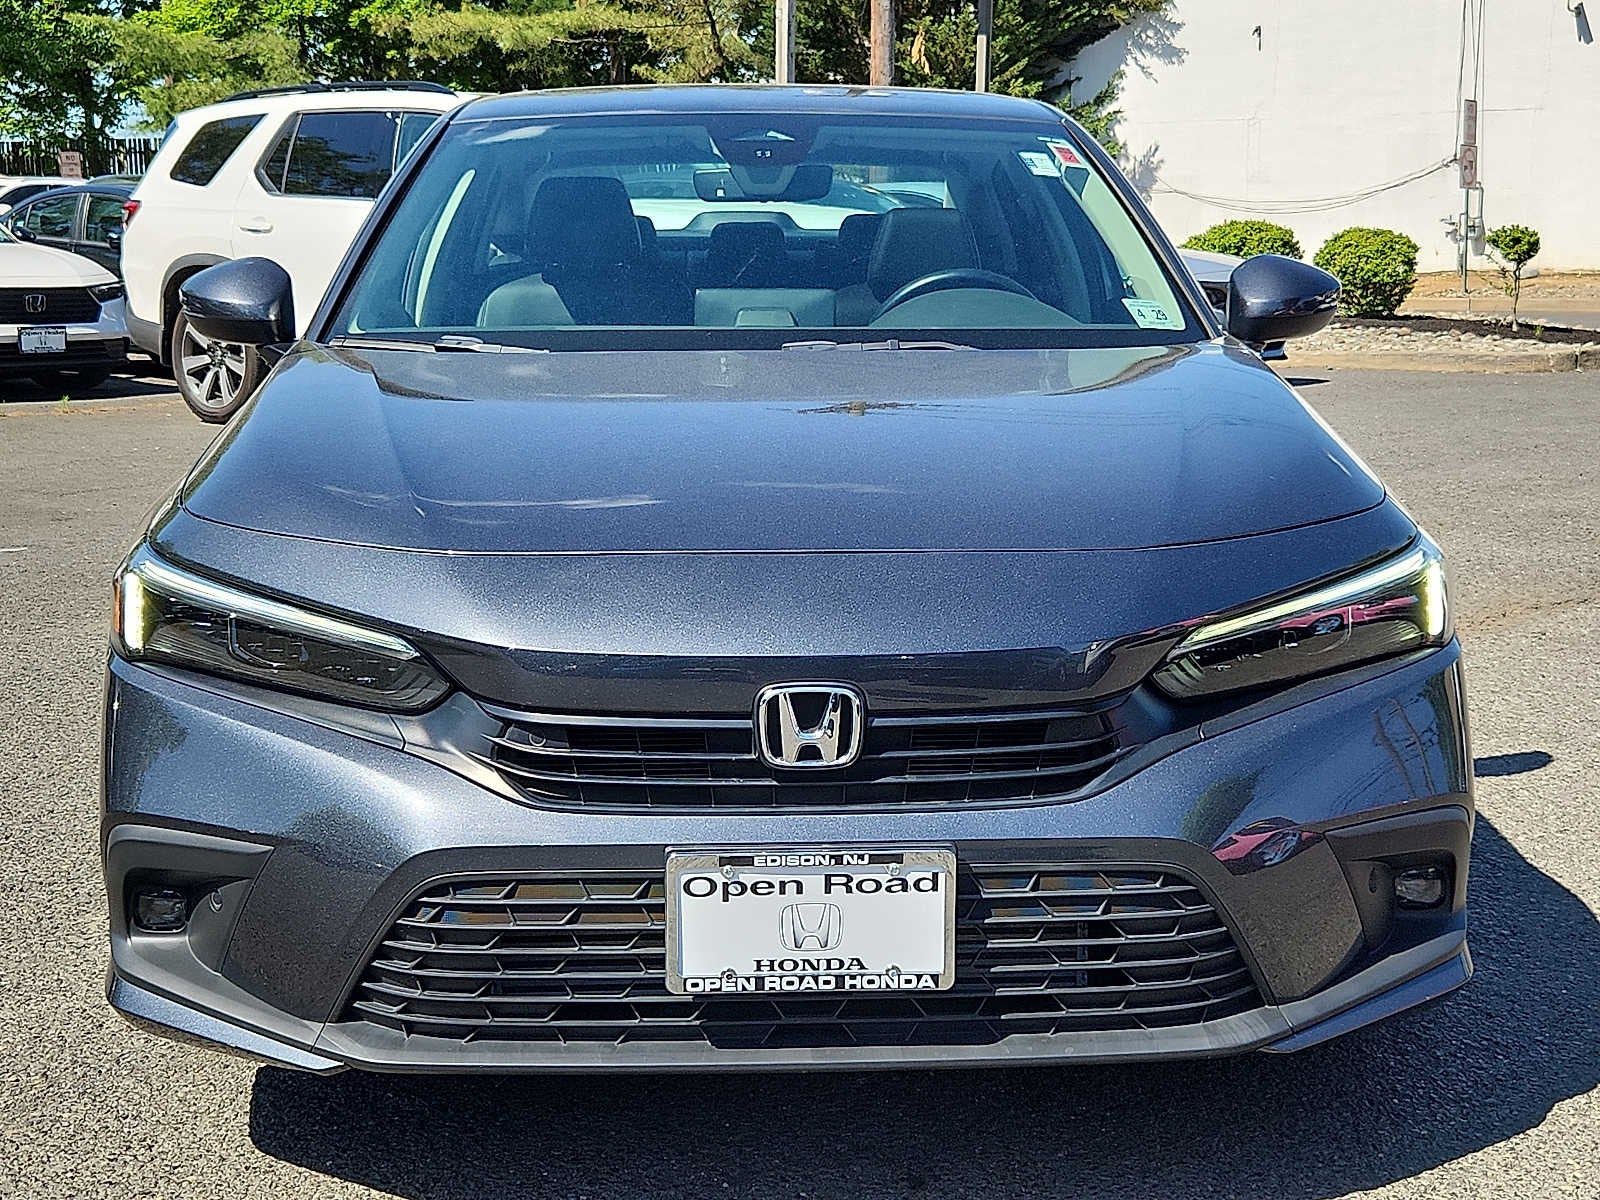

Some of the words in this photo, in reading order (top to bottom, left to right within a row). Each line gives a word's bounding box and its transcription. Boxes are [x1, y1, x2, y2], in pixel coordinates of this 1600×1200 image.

[753, 855, 836, 867] EDISON,
[842, 854, 870, 865] NJ
[682, 875, 804, 902] Open
[824, 872, 939, 895] Road
[753, 957, 869, 972] HONDA
[685, 976, 756, 992] OPEN
[763, 975, 836, 991] ROAD
[844, 974, 936, 990] HONDA
